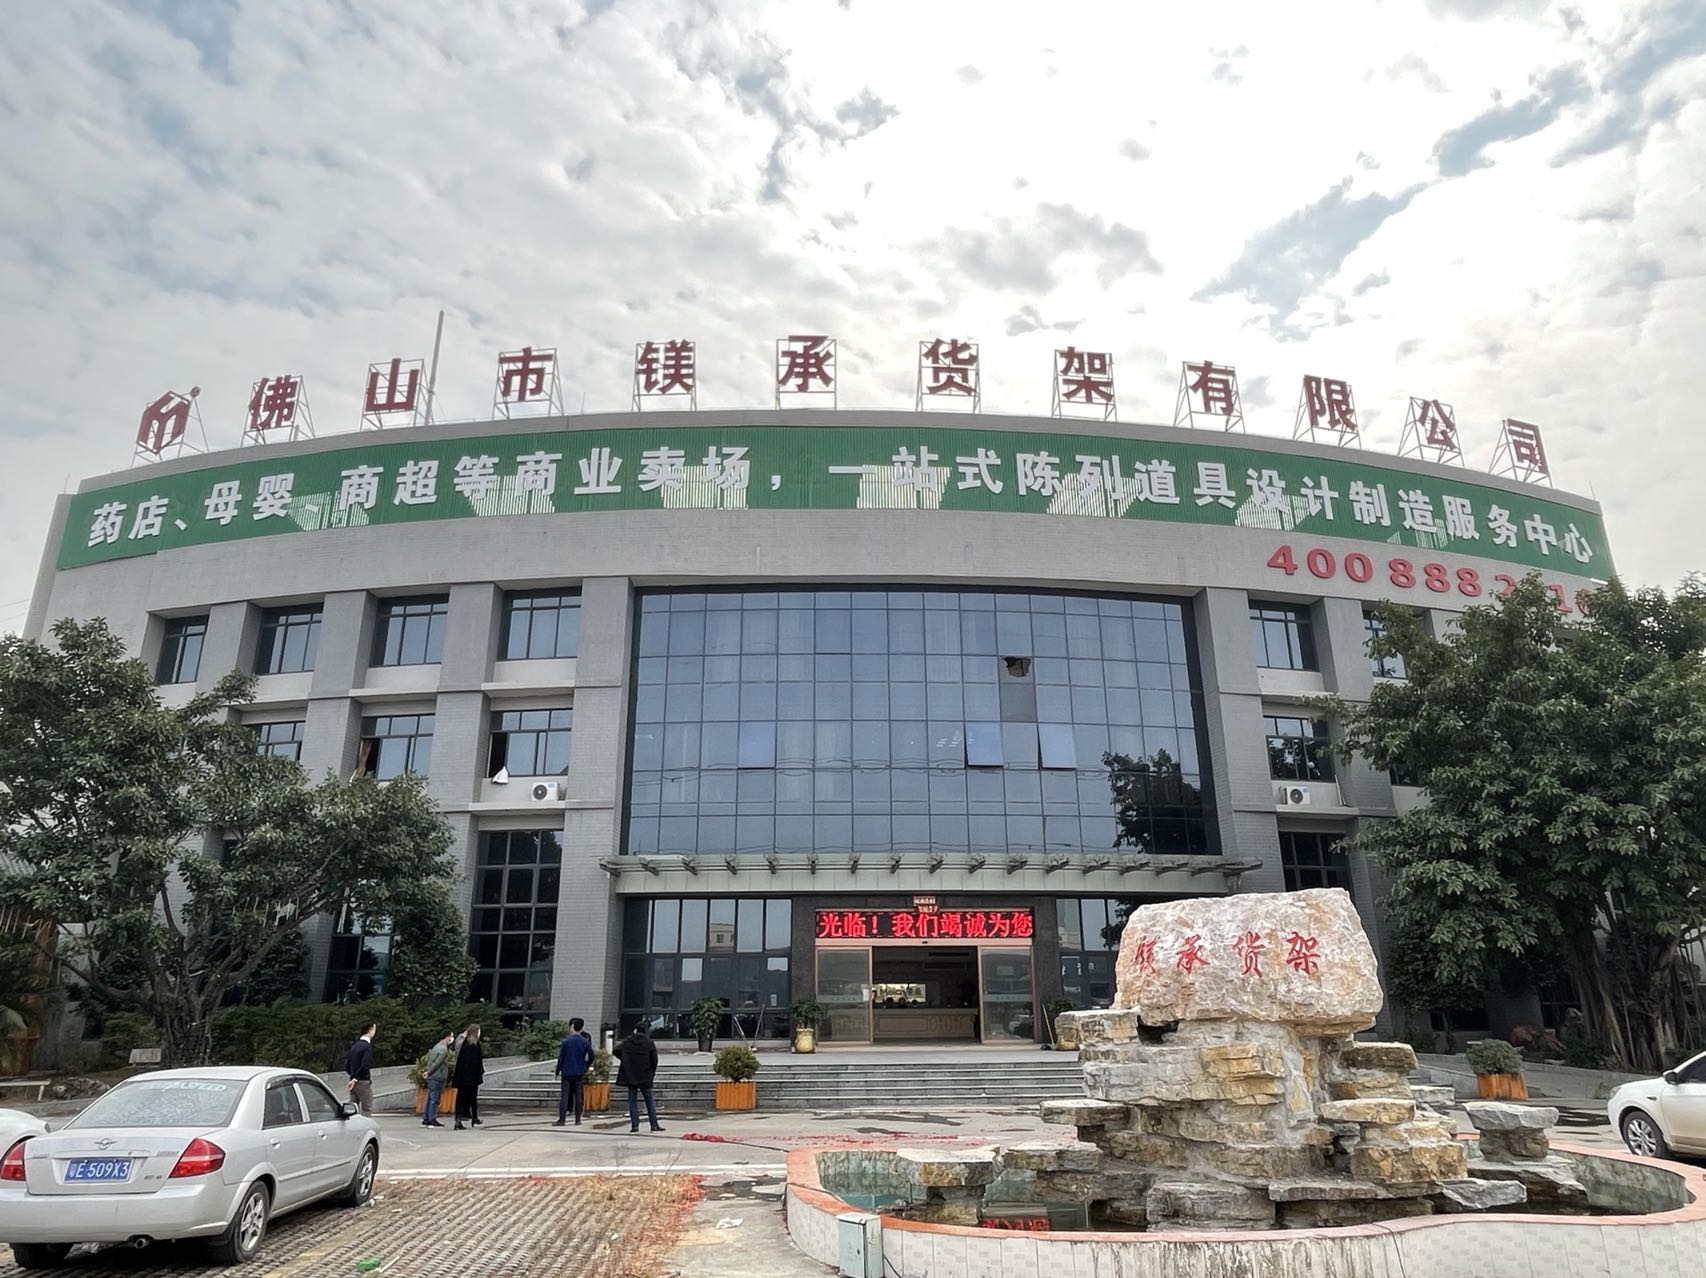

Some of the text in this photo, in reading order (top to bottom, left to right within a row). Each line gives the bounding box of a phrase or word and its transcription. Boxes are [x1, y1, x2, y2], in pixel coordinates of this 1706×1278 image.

[249, 335, 1549, 474] 佛山市镁承货架有限公司
